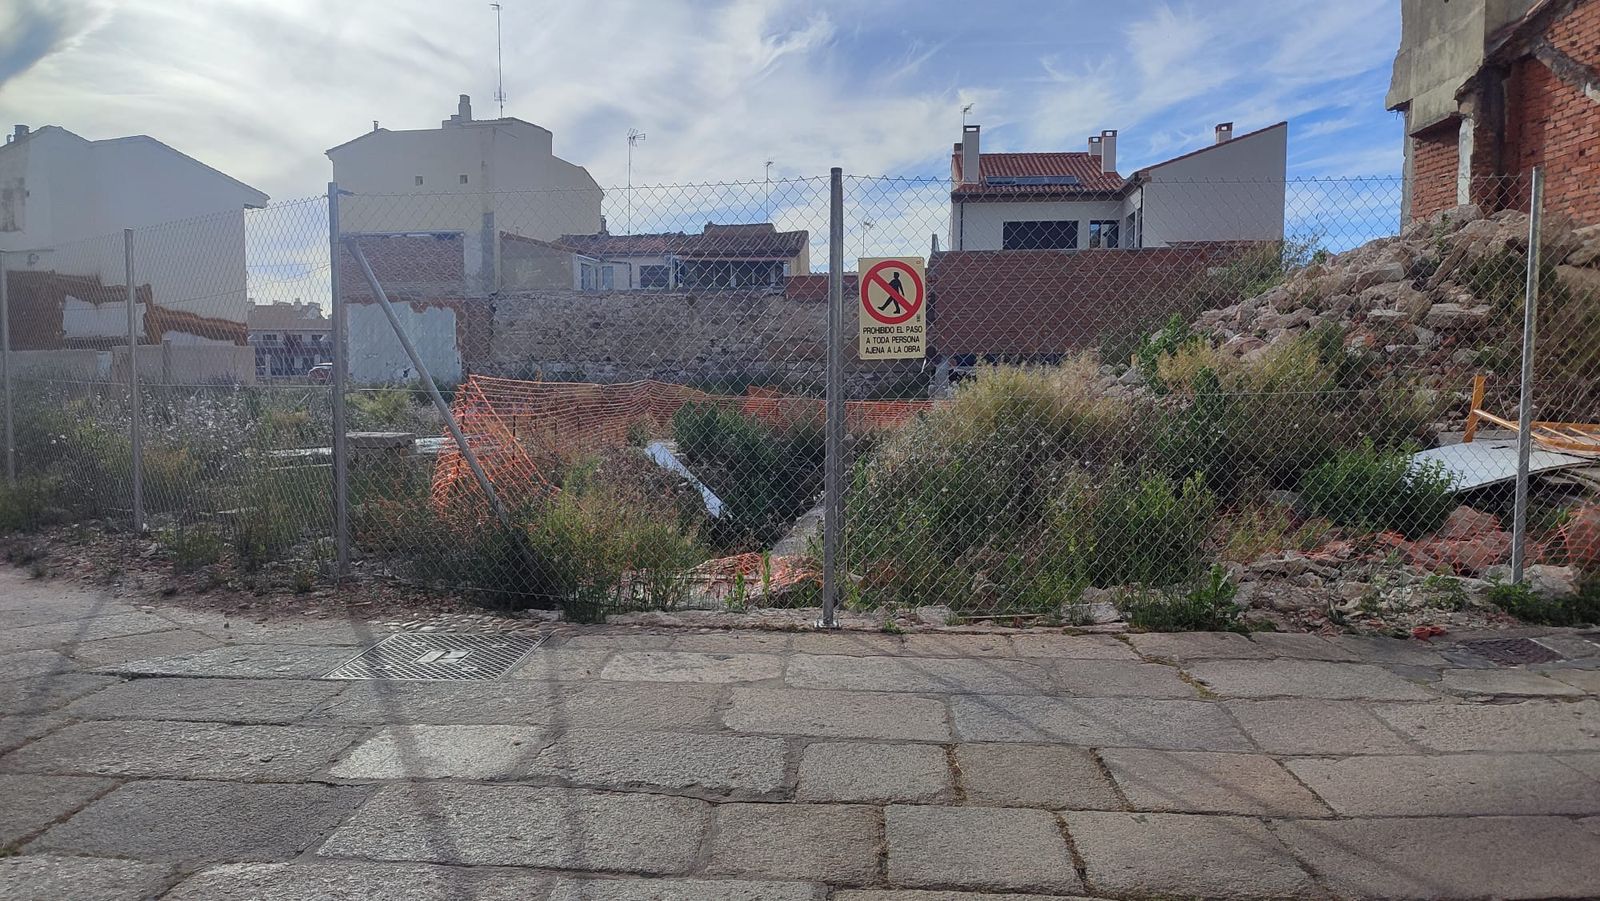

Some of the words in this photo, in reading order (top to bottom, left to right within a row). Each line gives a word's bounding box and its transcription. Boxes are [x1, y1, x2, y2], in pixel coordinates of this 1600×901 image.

[862, 326, 895, 334] PROHIBIDO
[905, 325, 923, 333] PASO
[873, 336, 890, 344] TODA
[865, 346, 885, 354] AJENA
[887, 346, 892, 354] A
[904, 345, 921, 353] OBRA
